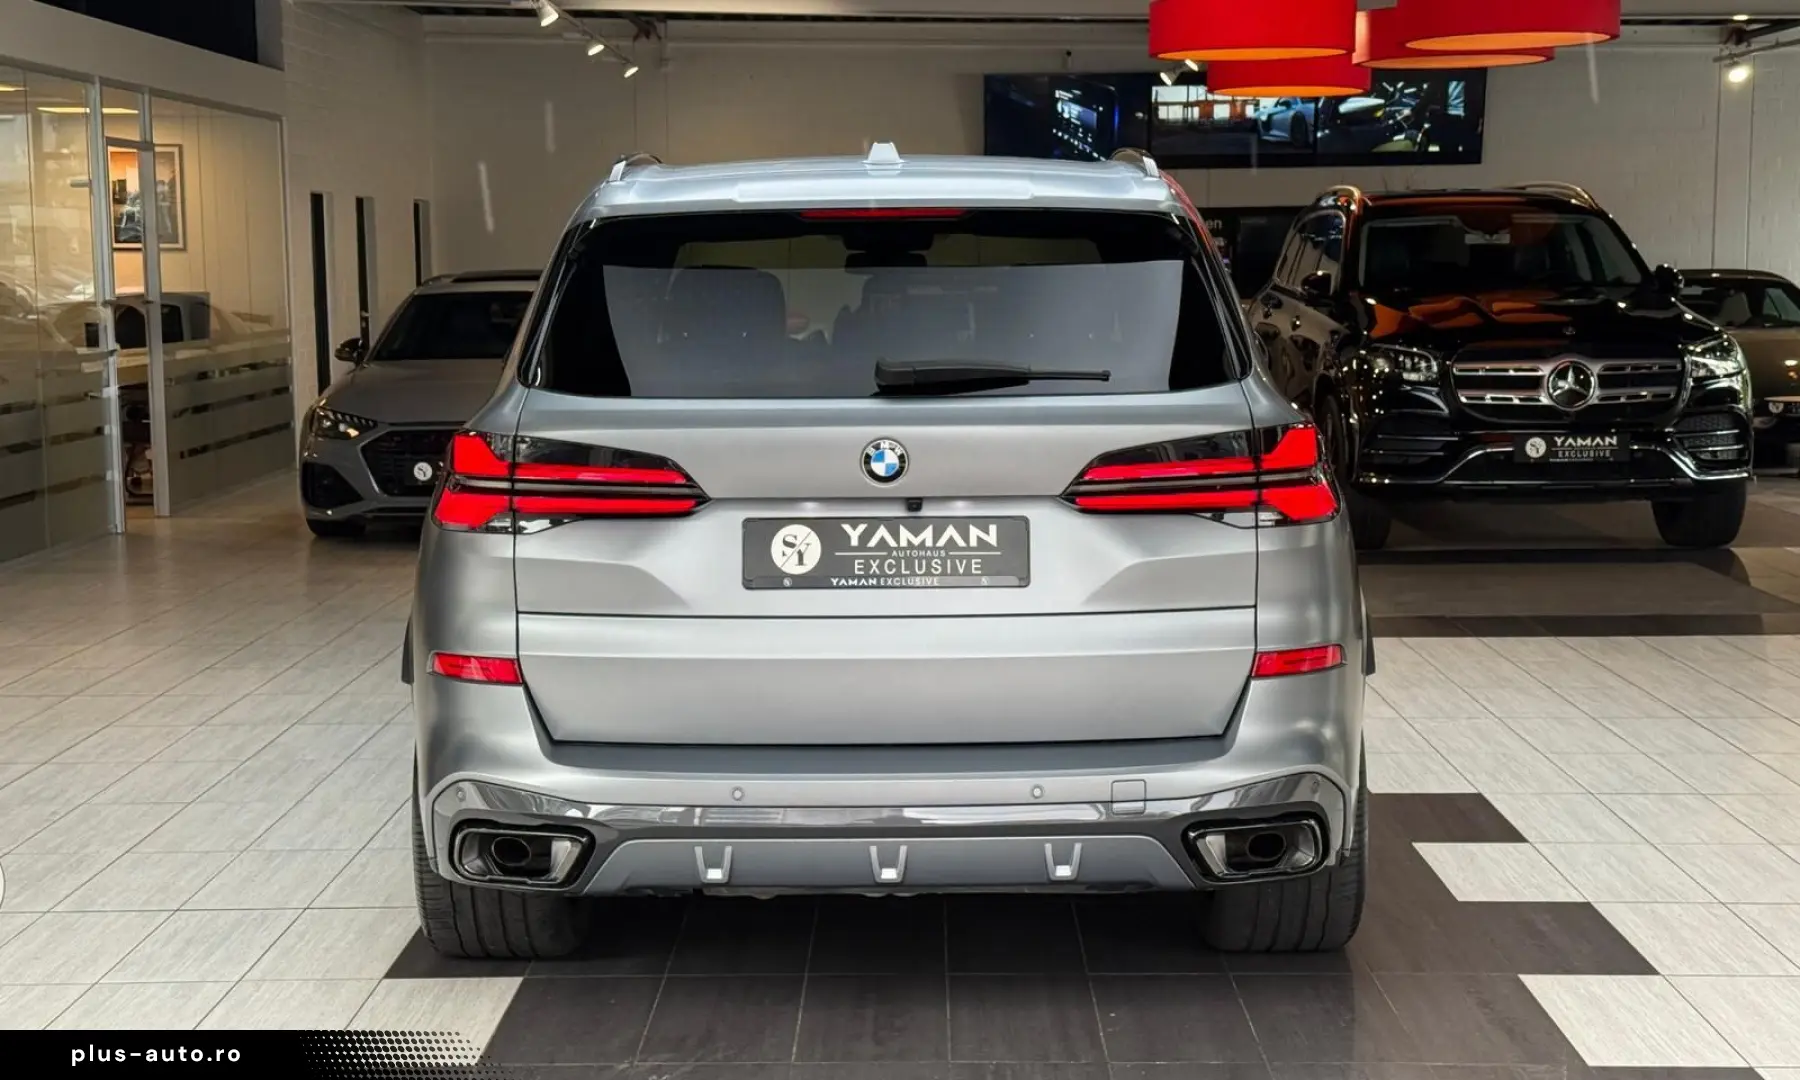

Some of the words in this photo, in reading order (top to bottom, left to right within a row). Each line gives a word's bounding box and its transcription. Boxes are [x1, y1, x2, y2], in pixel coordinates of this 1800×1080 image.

[1553, 436, 1617, 447] YAMAN
[1557, 450, 1611, 458] EXCLUSIVE
[841, 523, 998, 548] YAMAN
[854, 559, 982, 574] EXCLUSIVE
[830, 577, 877, 586] YAMAN
[880, 577, 939, 586] EXCLUSIVE
